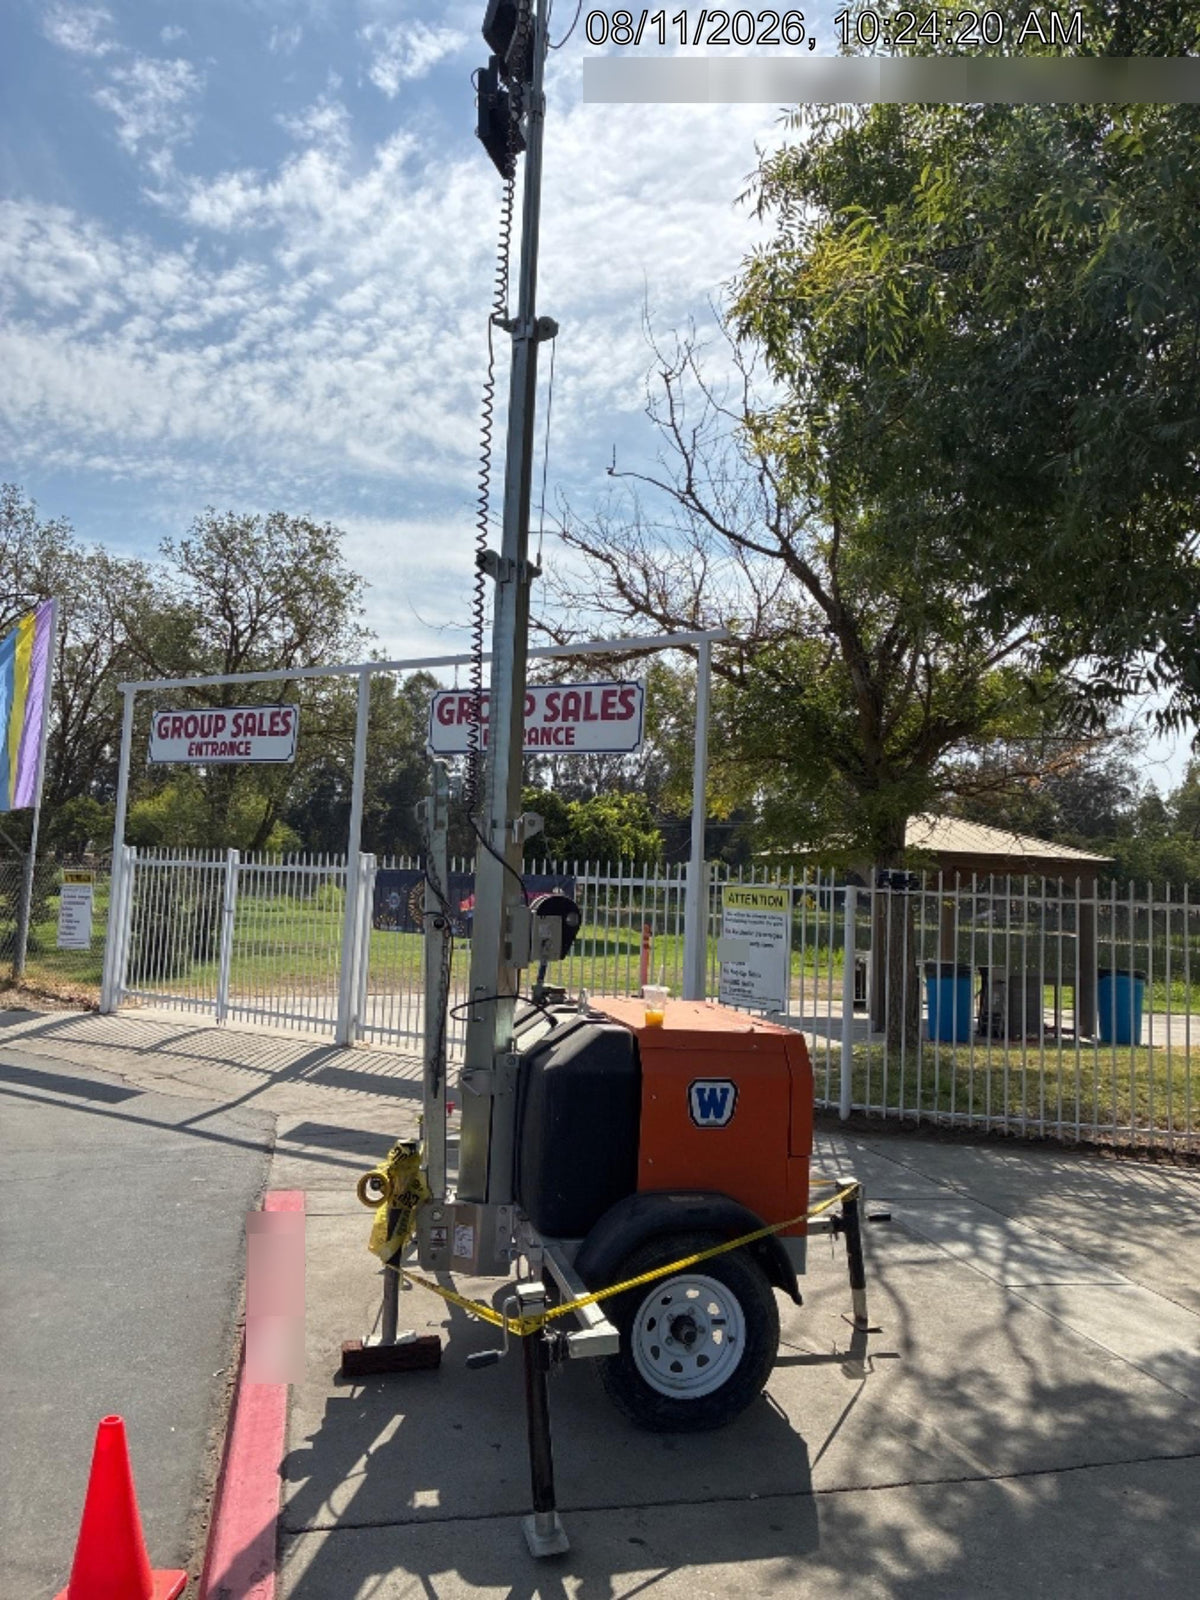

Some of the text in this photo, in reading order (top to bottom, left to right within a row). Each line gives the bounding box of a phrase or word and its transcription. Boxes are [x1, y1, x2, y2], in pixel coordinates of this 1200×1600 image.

[543, 690, 635, 722] SALES
[157, 710, 292, 739] GROUP SALES
[187, 741, 251, 757] ENTRANCE
[728, 892, 784, 907] ATTENTION
[695, 1087, 730, 1119] W
